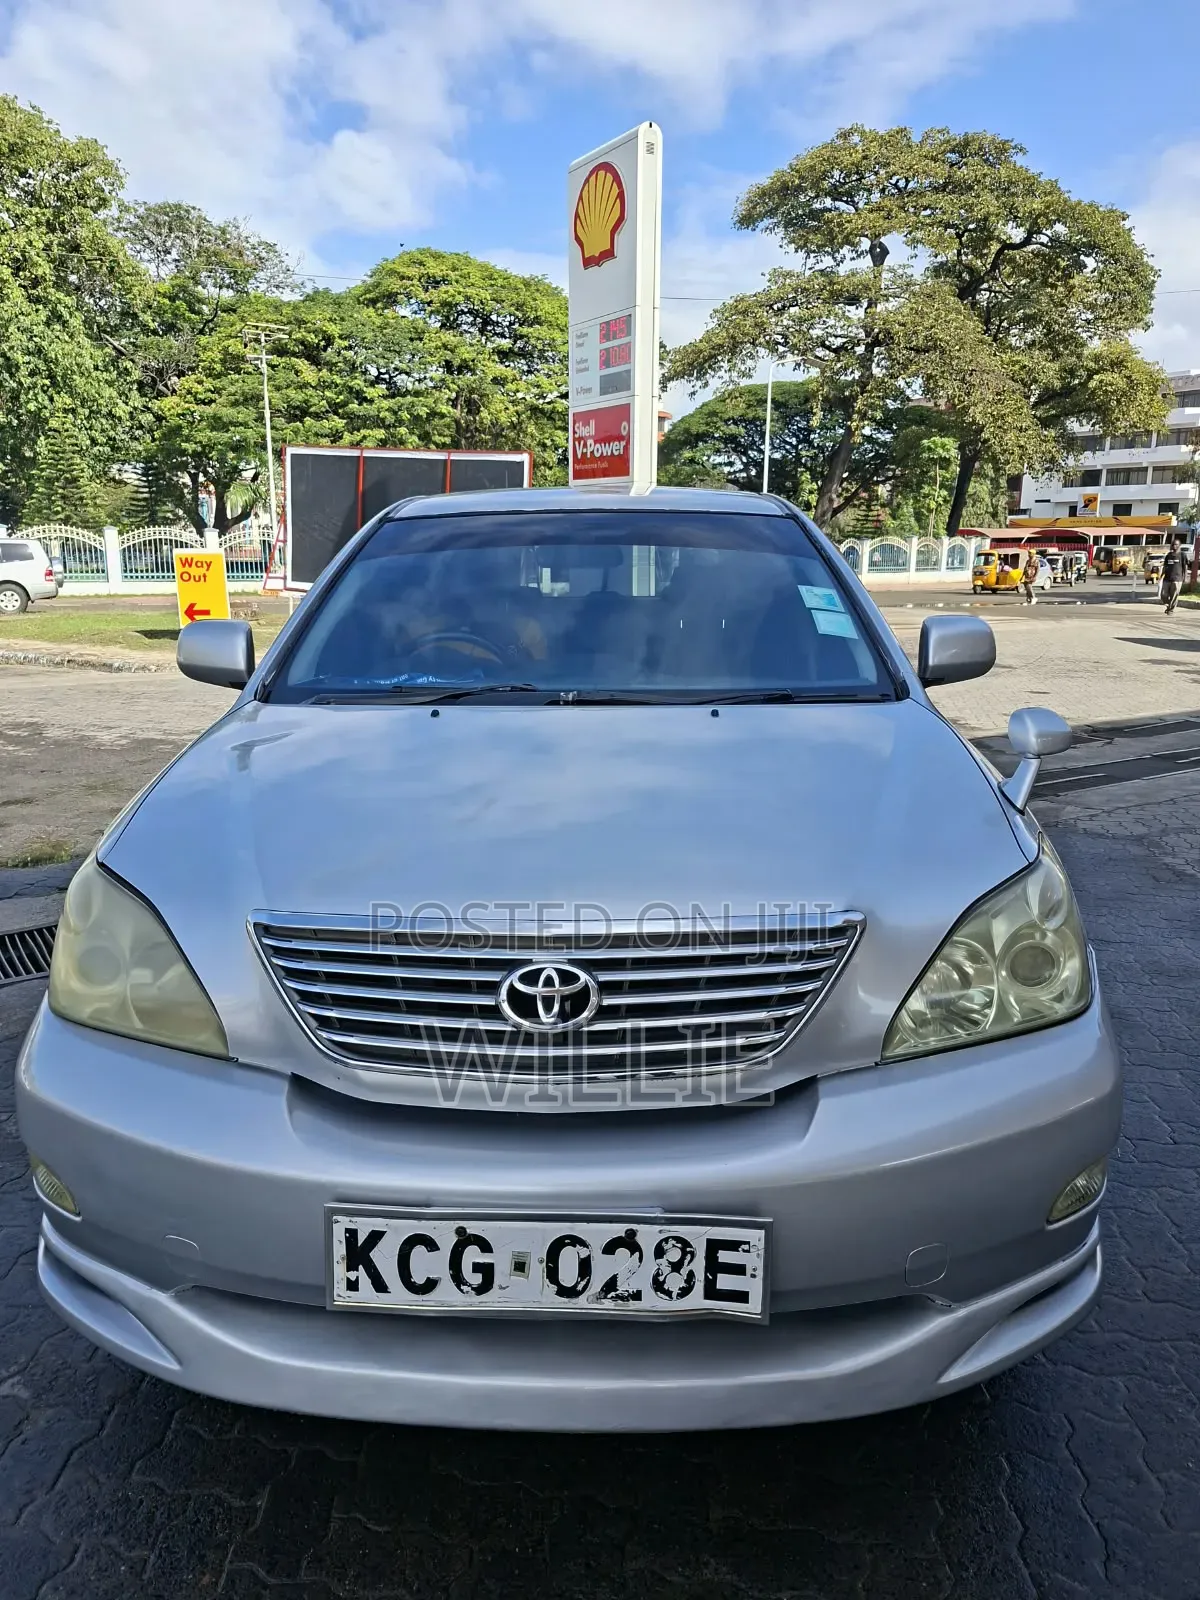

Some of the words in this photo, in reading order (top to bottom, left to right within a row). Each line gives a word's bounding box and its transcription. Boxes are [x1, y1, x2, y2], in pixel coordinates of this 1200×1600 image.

[574, 419, 595, 438] Shell
[574, 439, 626, 459] V-Power
[179, 557, 212, 571] Way
[179, 571, 207, 583] Out
[344, 1227, 495, 1297] KCG
[545, 1233, 751, 1305] 028E
